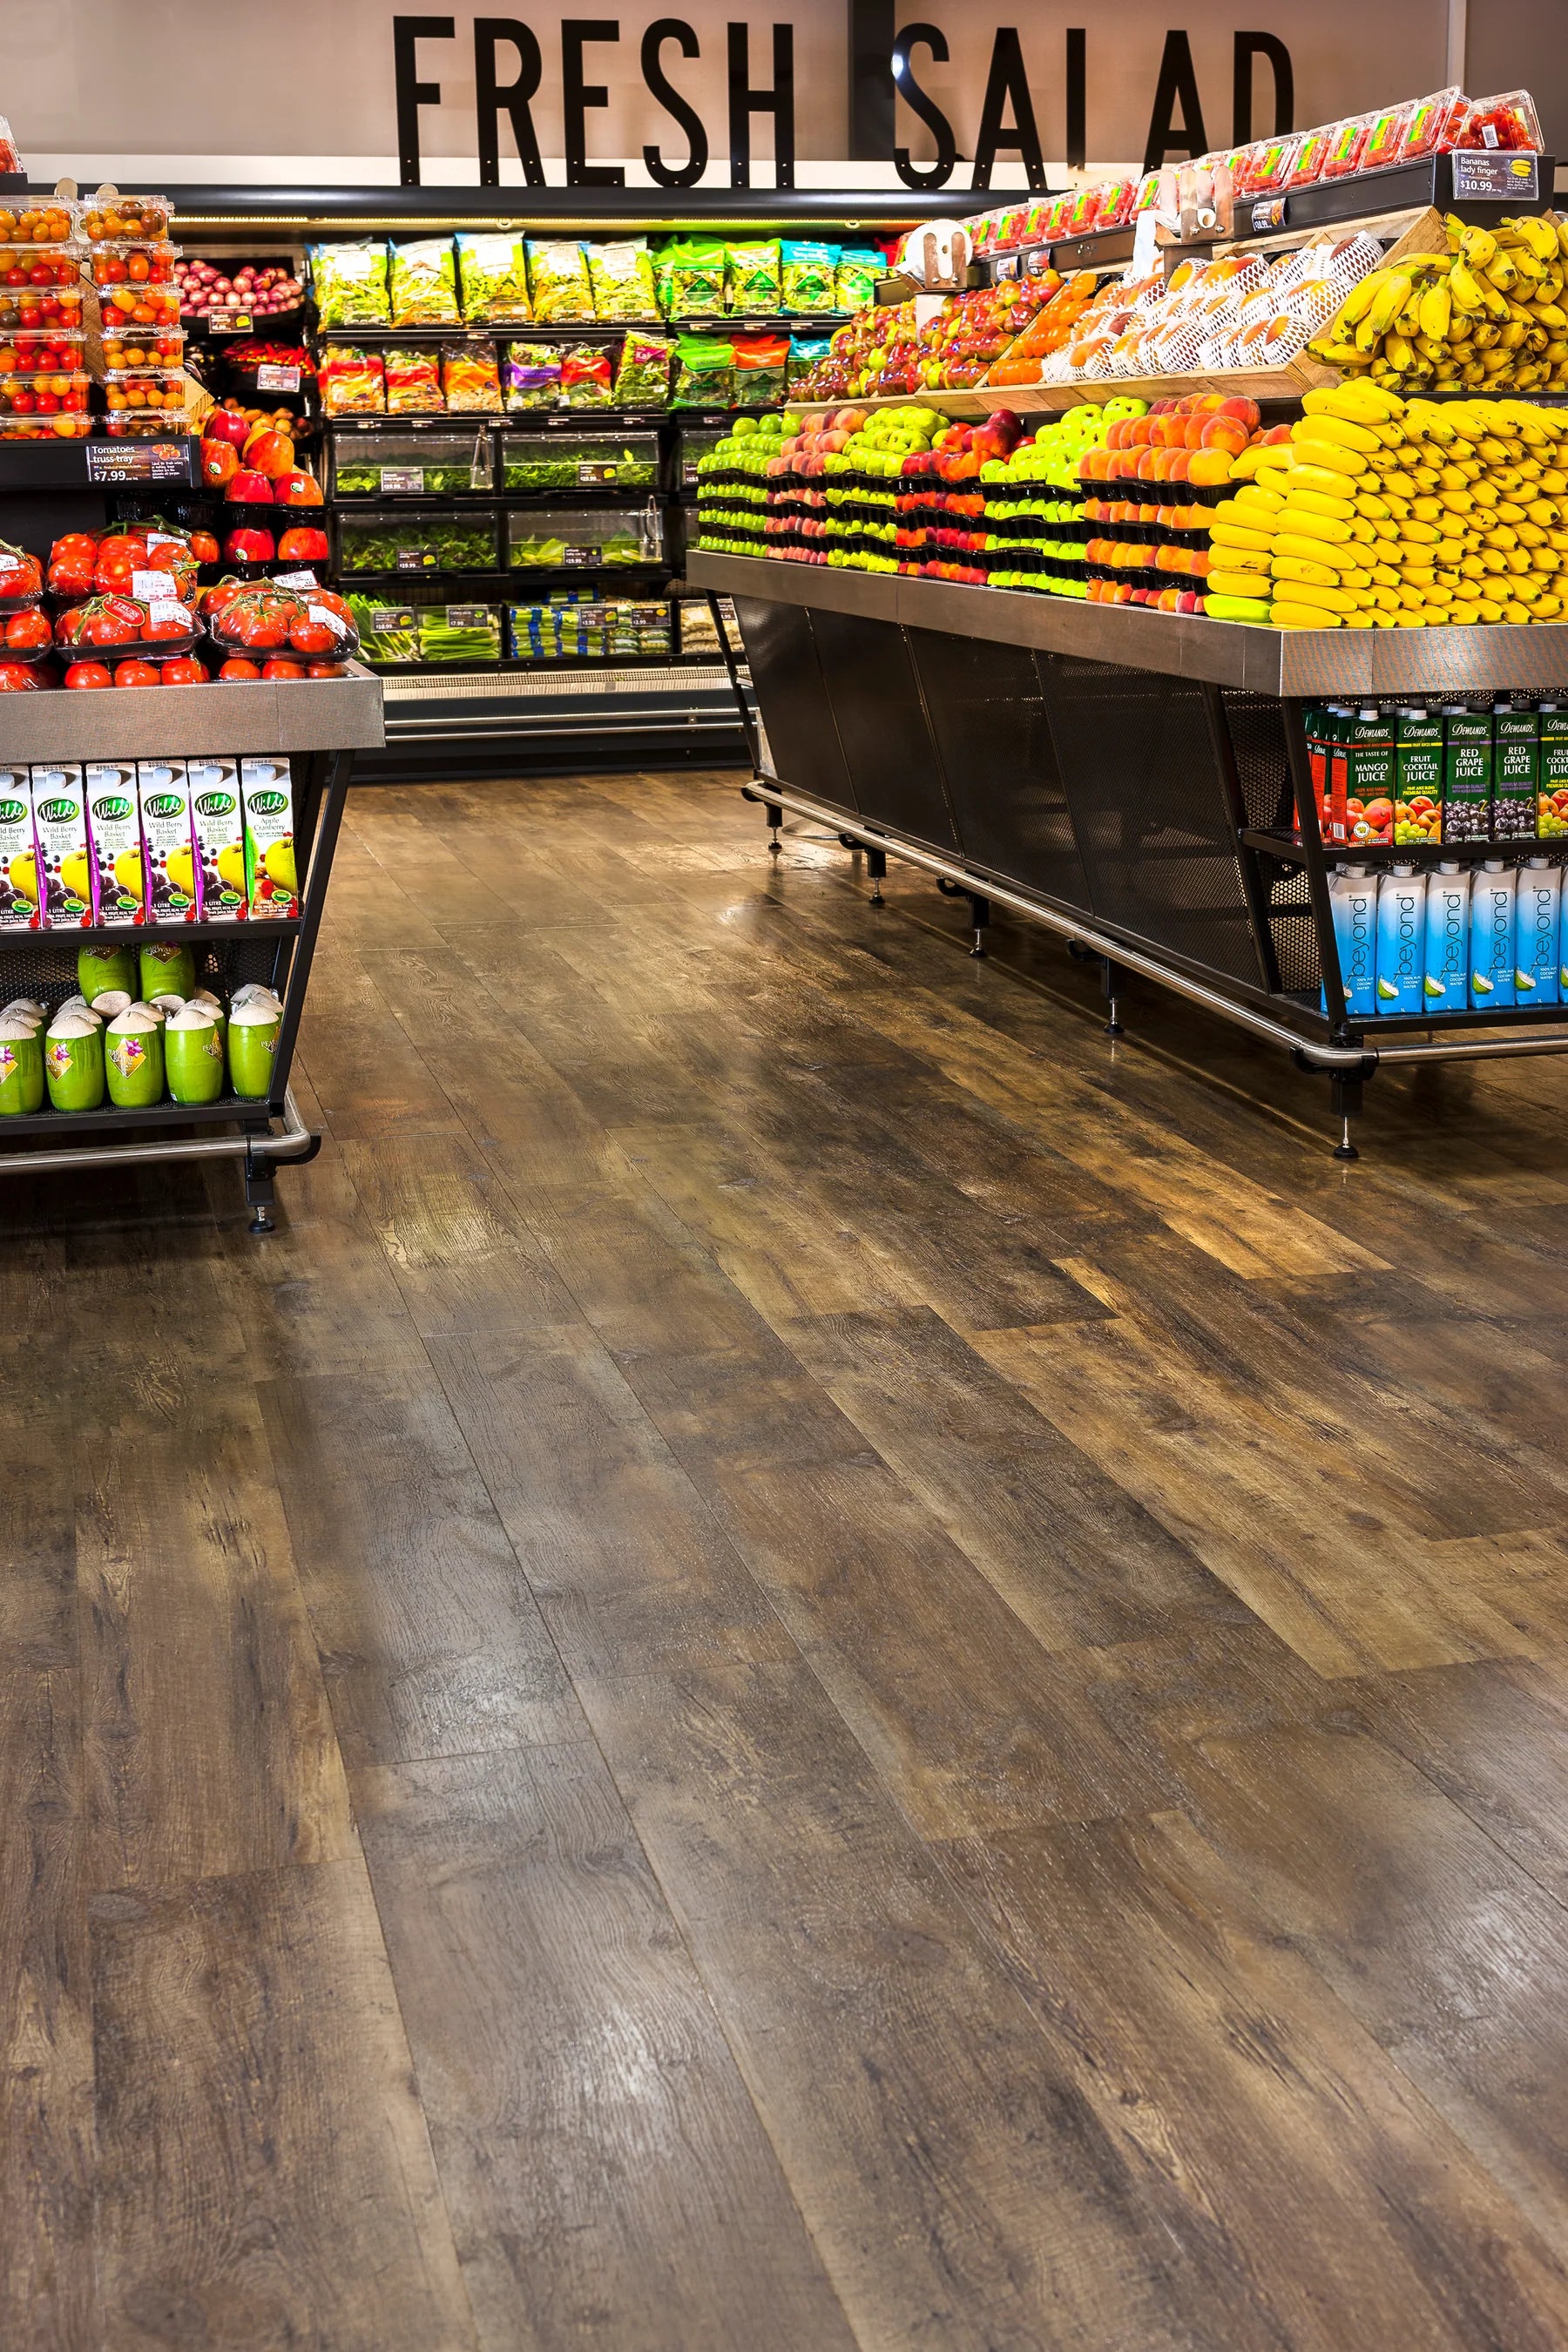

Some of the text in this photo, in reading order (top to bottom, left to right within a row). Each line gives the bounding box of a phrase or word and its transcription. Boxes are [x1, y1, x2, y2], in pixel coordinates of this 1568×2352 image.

[394, 17, 1294, 191] FRESH SALAD
[1460, 157, 1490, 166] Bananas
[1460, 166, 1498, 176] lady finger
[1460, 179, 1492, 191] $10.99
[91, 445, 135, 454] Tomatoes
[92, 455, 134, 463] truss tray
[93, 470, 126, 481] $7.99
[116, 601, 140, 618] TRUSS
[1355, 727, 1389, 739] DEWLANDS
[1403, 725, 1439, 738] DEWLANDS
[1451, 723, 1488, 736] DEWLANDS
[1500, 721, 1534, 733] DEWLANDS
[1460, 748, 1479, 757] RED
[1508, 746, 1526, 755] RED
[1504, 755, 1531, 764] GRAPE
[1355, 763, 1389, 772] MANGO
[1456, 767, 1484, 778] JUICE
[1504, 764, 1531, 775] JUICE
[1357, 771, 1386, 783] JUICE
[1407, 771, 1436, 782] JUICE
[93, 798, 130, 820] Wilde
[145, 796, 180, 817] Wilde
[197, 794, 231, 815] Wilde
[249, 793, 284, 814] Wilde
[0, 801, 24, 820] ilde
[40, 800, 75, 821] Wilde
[260, 817, 280, 826] Apple
[9, 827, 26, 835] Berry
[1441, 894, 1463, 973] beyond
[1489, 891, 1511, 970] beyond
[1531, 889, 1553, 967] beyond
[1347, 898, 1370, 977] beyond
[1394, 896, 1416, 976] beyond
